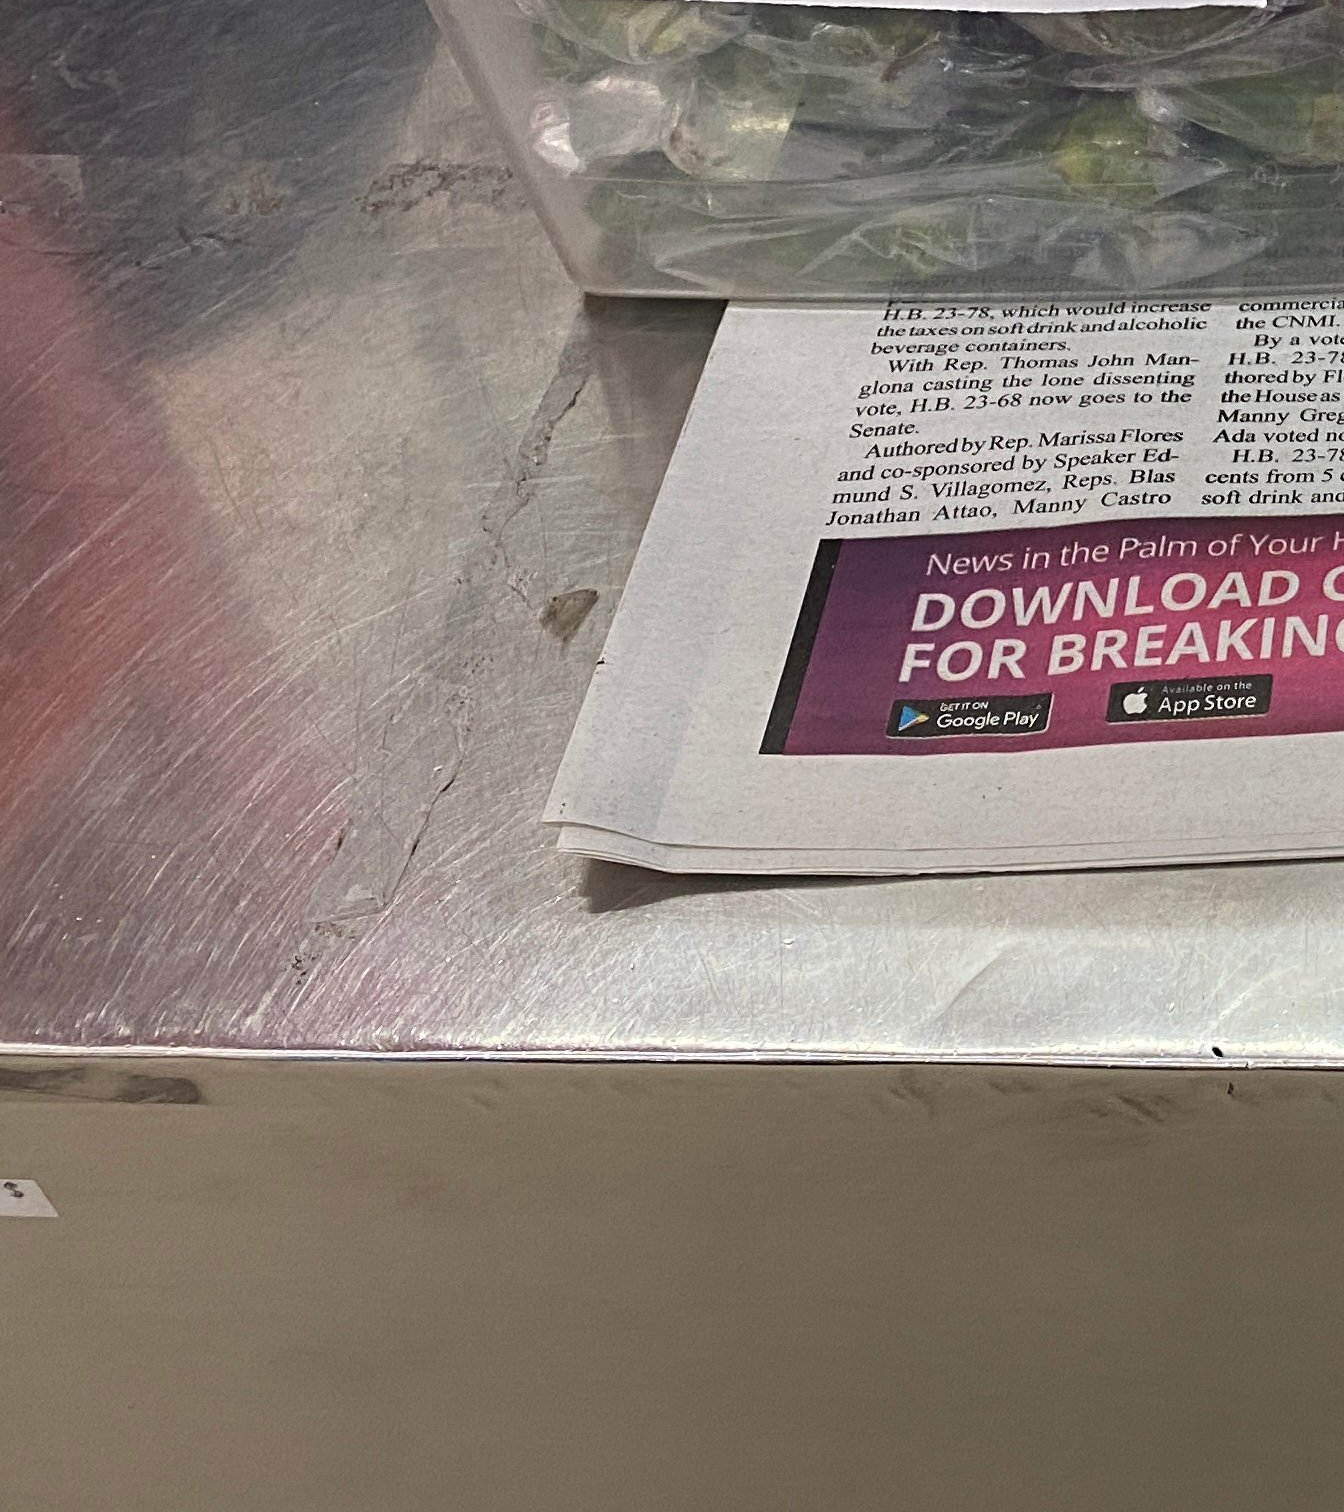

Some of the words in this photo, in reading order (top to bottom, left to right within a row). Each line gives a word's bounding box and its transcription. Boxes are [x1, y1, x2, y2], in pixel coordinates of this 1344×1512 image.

[855, 403, 902, 417] vote,
[910, 397, 955, 413] H.B.
[963, 393, 1023, 410] 23-68
[1028, 394, 1073, 406] now
[1078, 393, 1126, 408] goes
[1133, 392, 1153, 404] to
[1160, 389, 1193, 403] the
[1221, 389, 1252, 404] the
[1254, 389, 1318, 403] House
[1320, 392, 1341, 403] as
[1216, 409, 1290, 426] Manny
[849, 422, 920, 439] Senate.
[1212, 428, 1256, 444] Ada
[1263, 427, 1319, 443] voted
[863, 437, 959, 459] Authored
[961, 437, 987, 456] by
[989, 435, 1033, 453] Rep.
[1038, 431, 1116, 448] Marissa
[1119, 428, 1184, 443] Flores
[837, 465, 875, 482] and
[880, 454, 1016, 482] co-sponsored
[1021, 454, 1048, 474] by
[1053, 449, 1137, 472] Speaker
[1142, 447, 1180, 463] Ed-
[1232, 449, 1279, 463] H.B.
[1205, 471, 1259, 484] cents
[1265, 468, 1315, 484] from
[1321, 468, 1334, 483] 5
[832, 485, 891, 504] mund
[899, 484, 918, 501] S.
[931, 480, 1052, 500] Villagomez,
[1062, 474, 1113, 491] Reps.
[1129, 468, 1176, 484] Blas
[1201, 489, 1242, 505] soft
[1248, 489, 1303, 505] drink
[825, 507, 921, 526] Jonathan
[932, 504, 997, 521] Attao,
[1013, 498, 1087, 515] Manny
[1100, 491, 1172, 507] Castro
[926, 554, 1013, 575] News
[1023, 548, 1049, 568] in
[1061, 542, 1109, 566] the
[1120, 536, 1196, 560] Palm
[1208, 534, 1242, 556] of
[1250, 533, 1323, 555] Your
[913, 568, 1300, 631] DOWNLOAD
[899, 639, 1026, 682] FOR
[1162, 683, 1213, 694] Available
[1214, 683, 1231, 692] on
[1234, 681, 1252, 691] the
[940, 703, 960, 711] GET
[1158, 698, 1199, 715] App
[1204, 695, 1256, 710] Store
[937, 712, 999, 729] Google
[1004, 712, 1039, 727] Play
